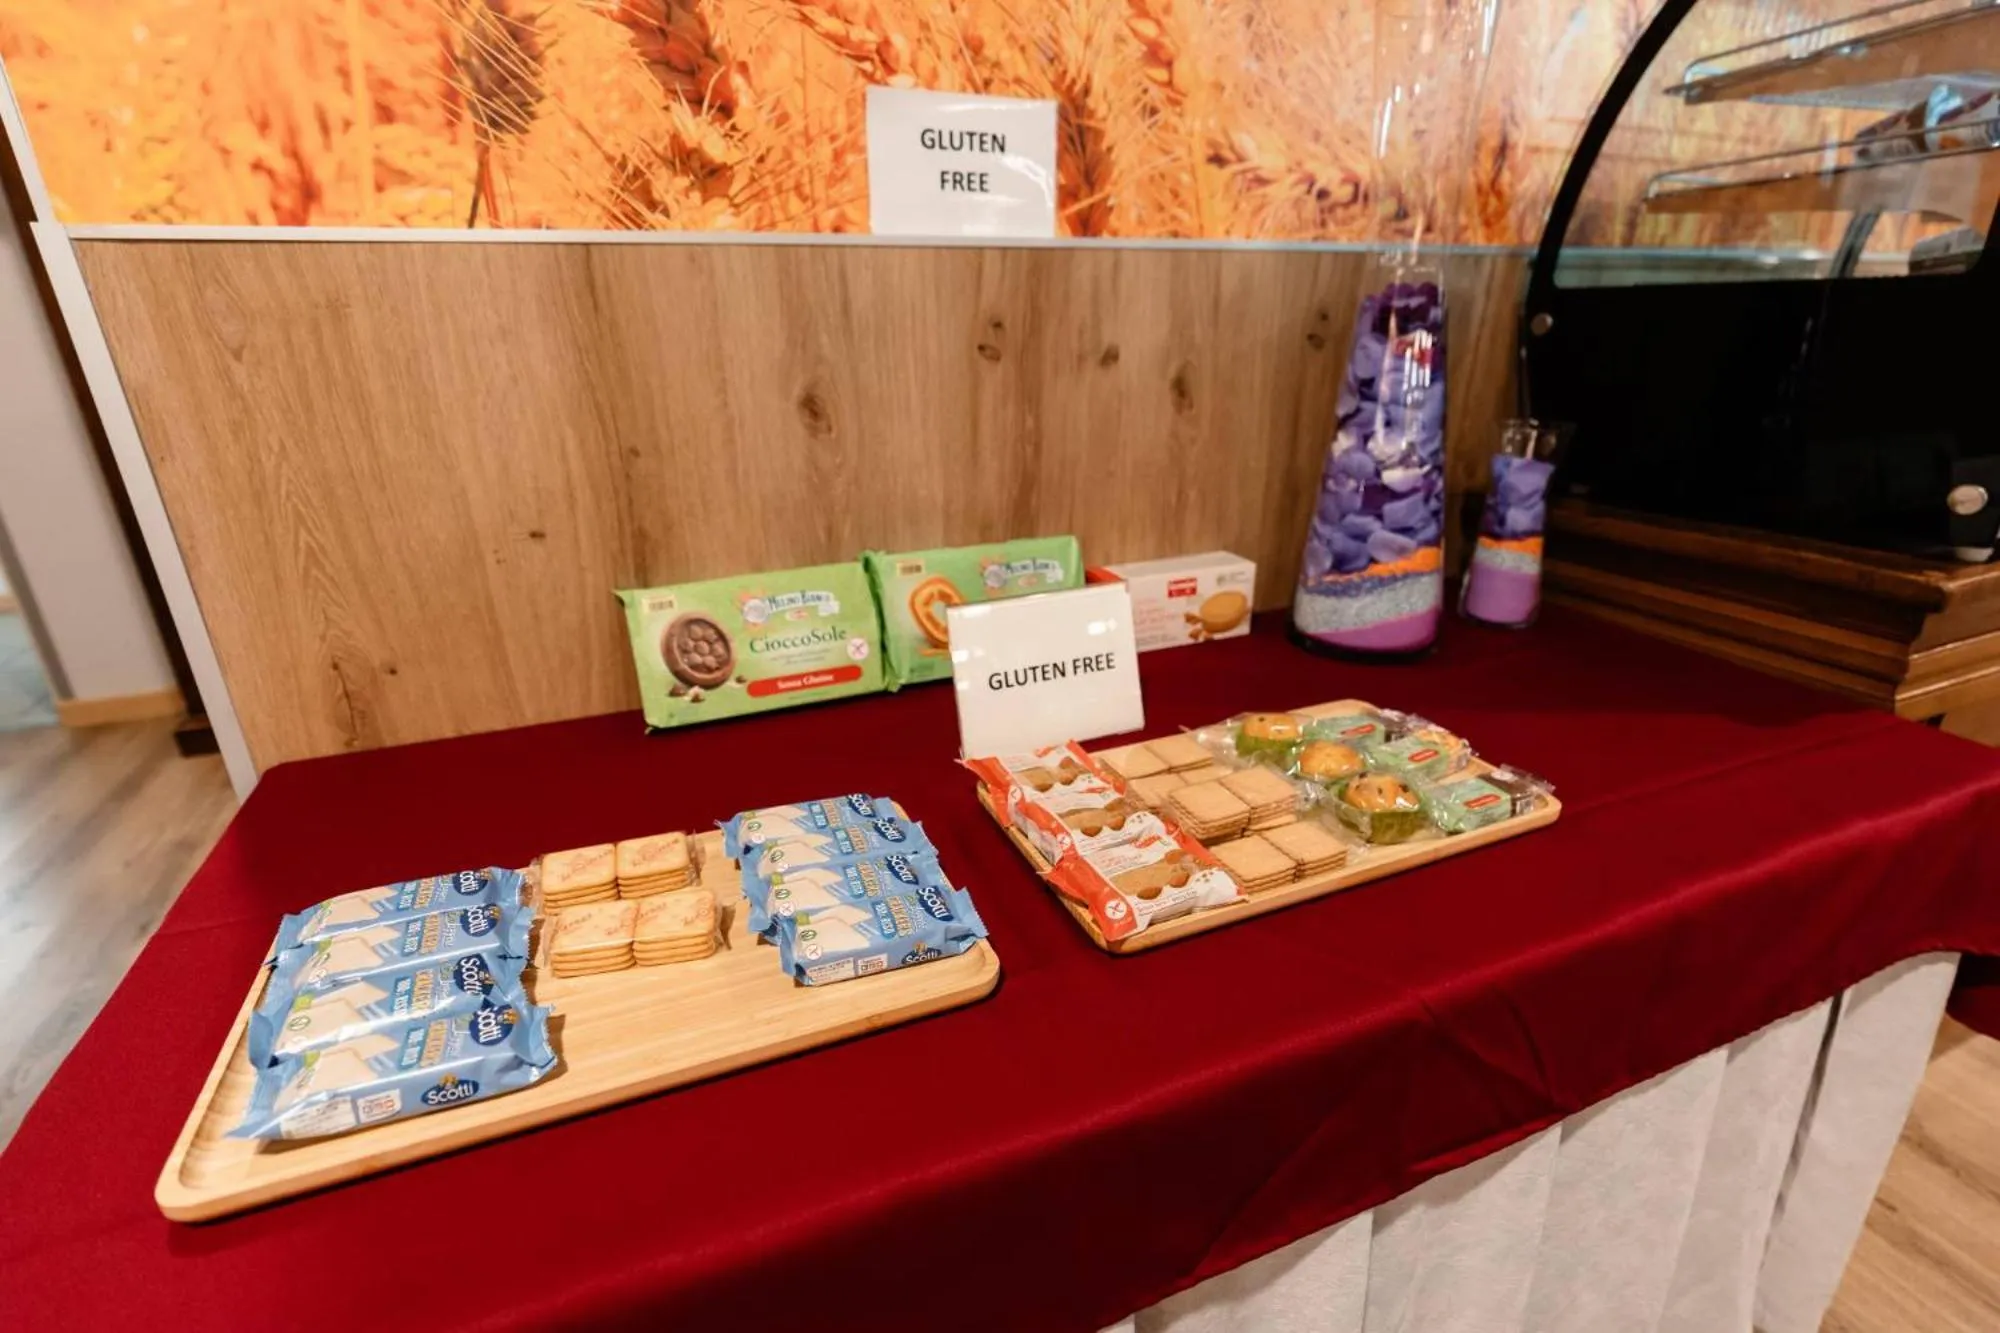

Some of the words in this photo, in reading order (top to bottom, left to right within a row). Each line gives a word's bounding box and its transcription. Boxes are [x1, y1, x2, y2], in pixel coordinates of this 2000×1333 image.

[920, 128, 1006, 153] GLUTEN
[939, 170, 991, 193] FREE
[749, 625, 847, 653] CioccoSole
[988, 661, 1067, 691] GLUTEN
[1072, 652, 1117, 676] FREE
[887, 855, 914, 882] Scotti
[918, 887, 947, 919] Scotti
[427, 1081, 475, 1105] Scotti
